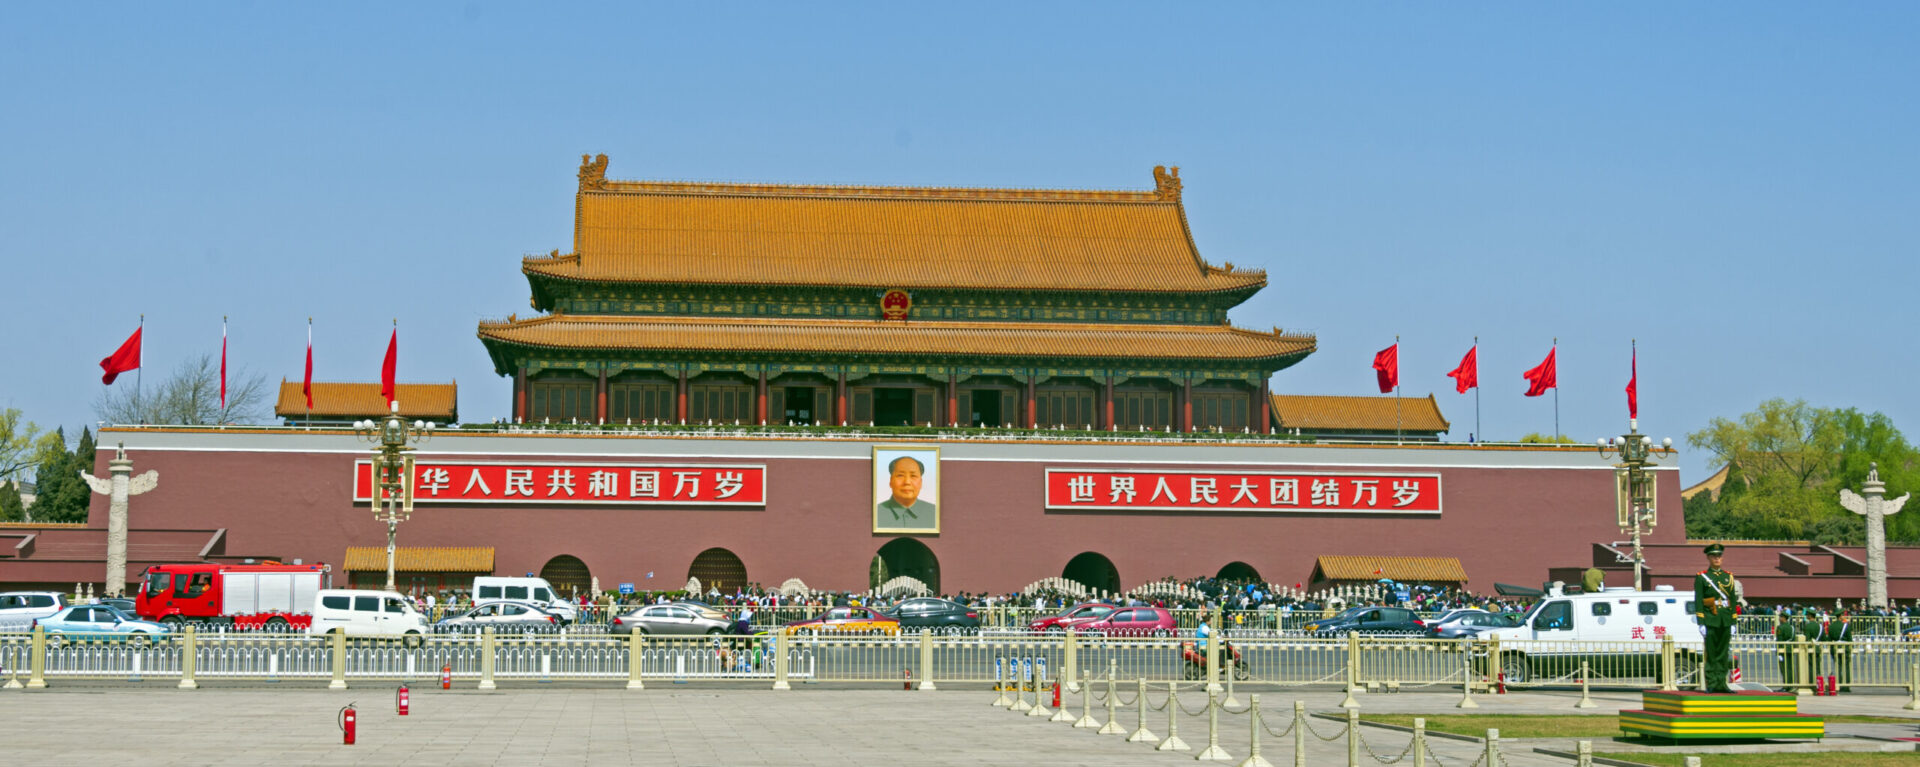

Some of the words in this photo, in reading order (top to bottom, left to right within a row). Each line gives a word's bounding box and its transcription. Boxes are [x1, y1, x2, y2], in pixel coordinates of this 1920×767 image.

[380, 468, 744, 499] 华人民共和国万岁
[1068, 475, 1421, 506] 世界人民大团结万岁
[1631, 626, 1667, 640] 武警
